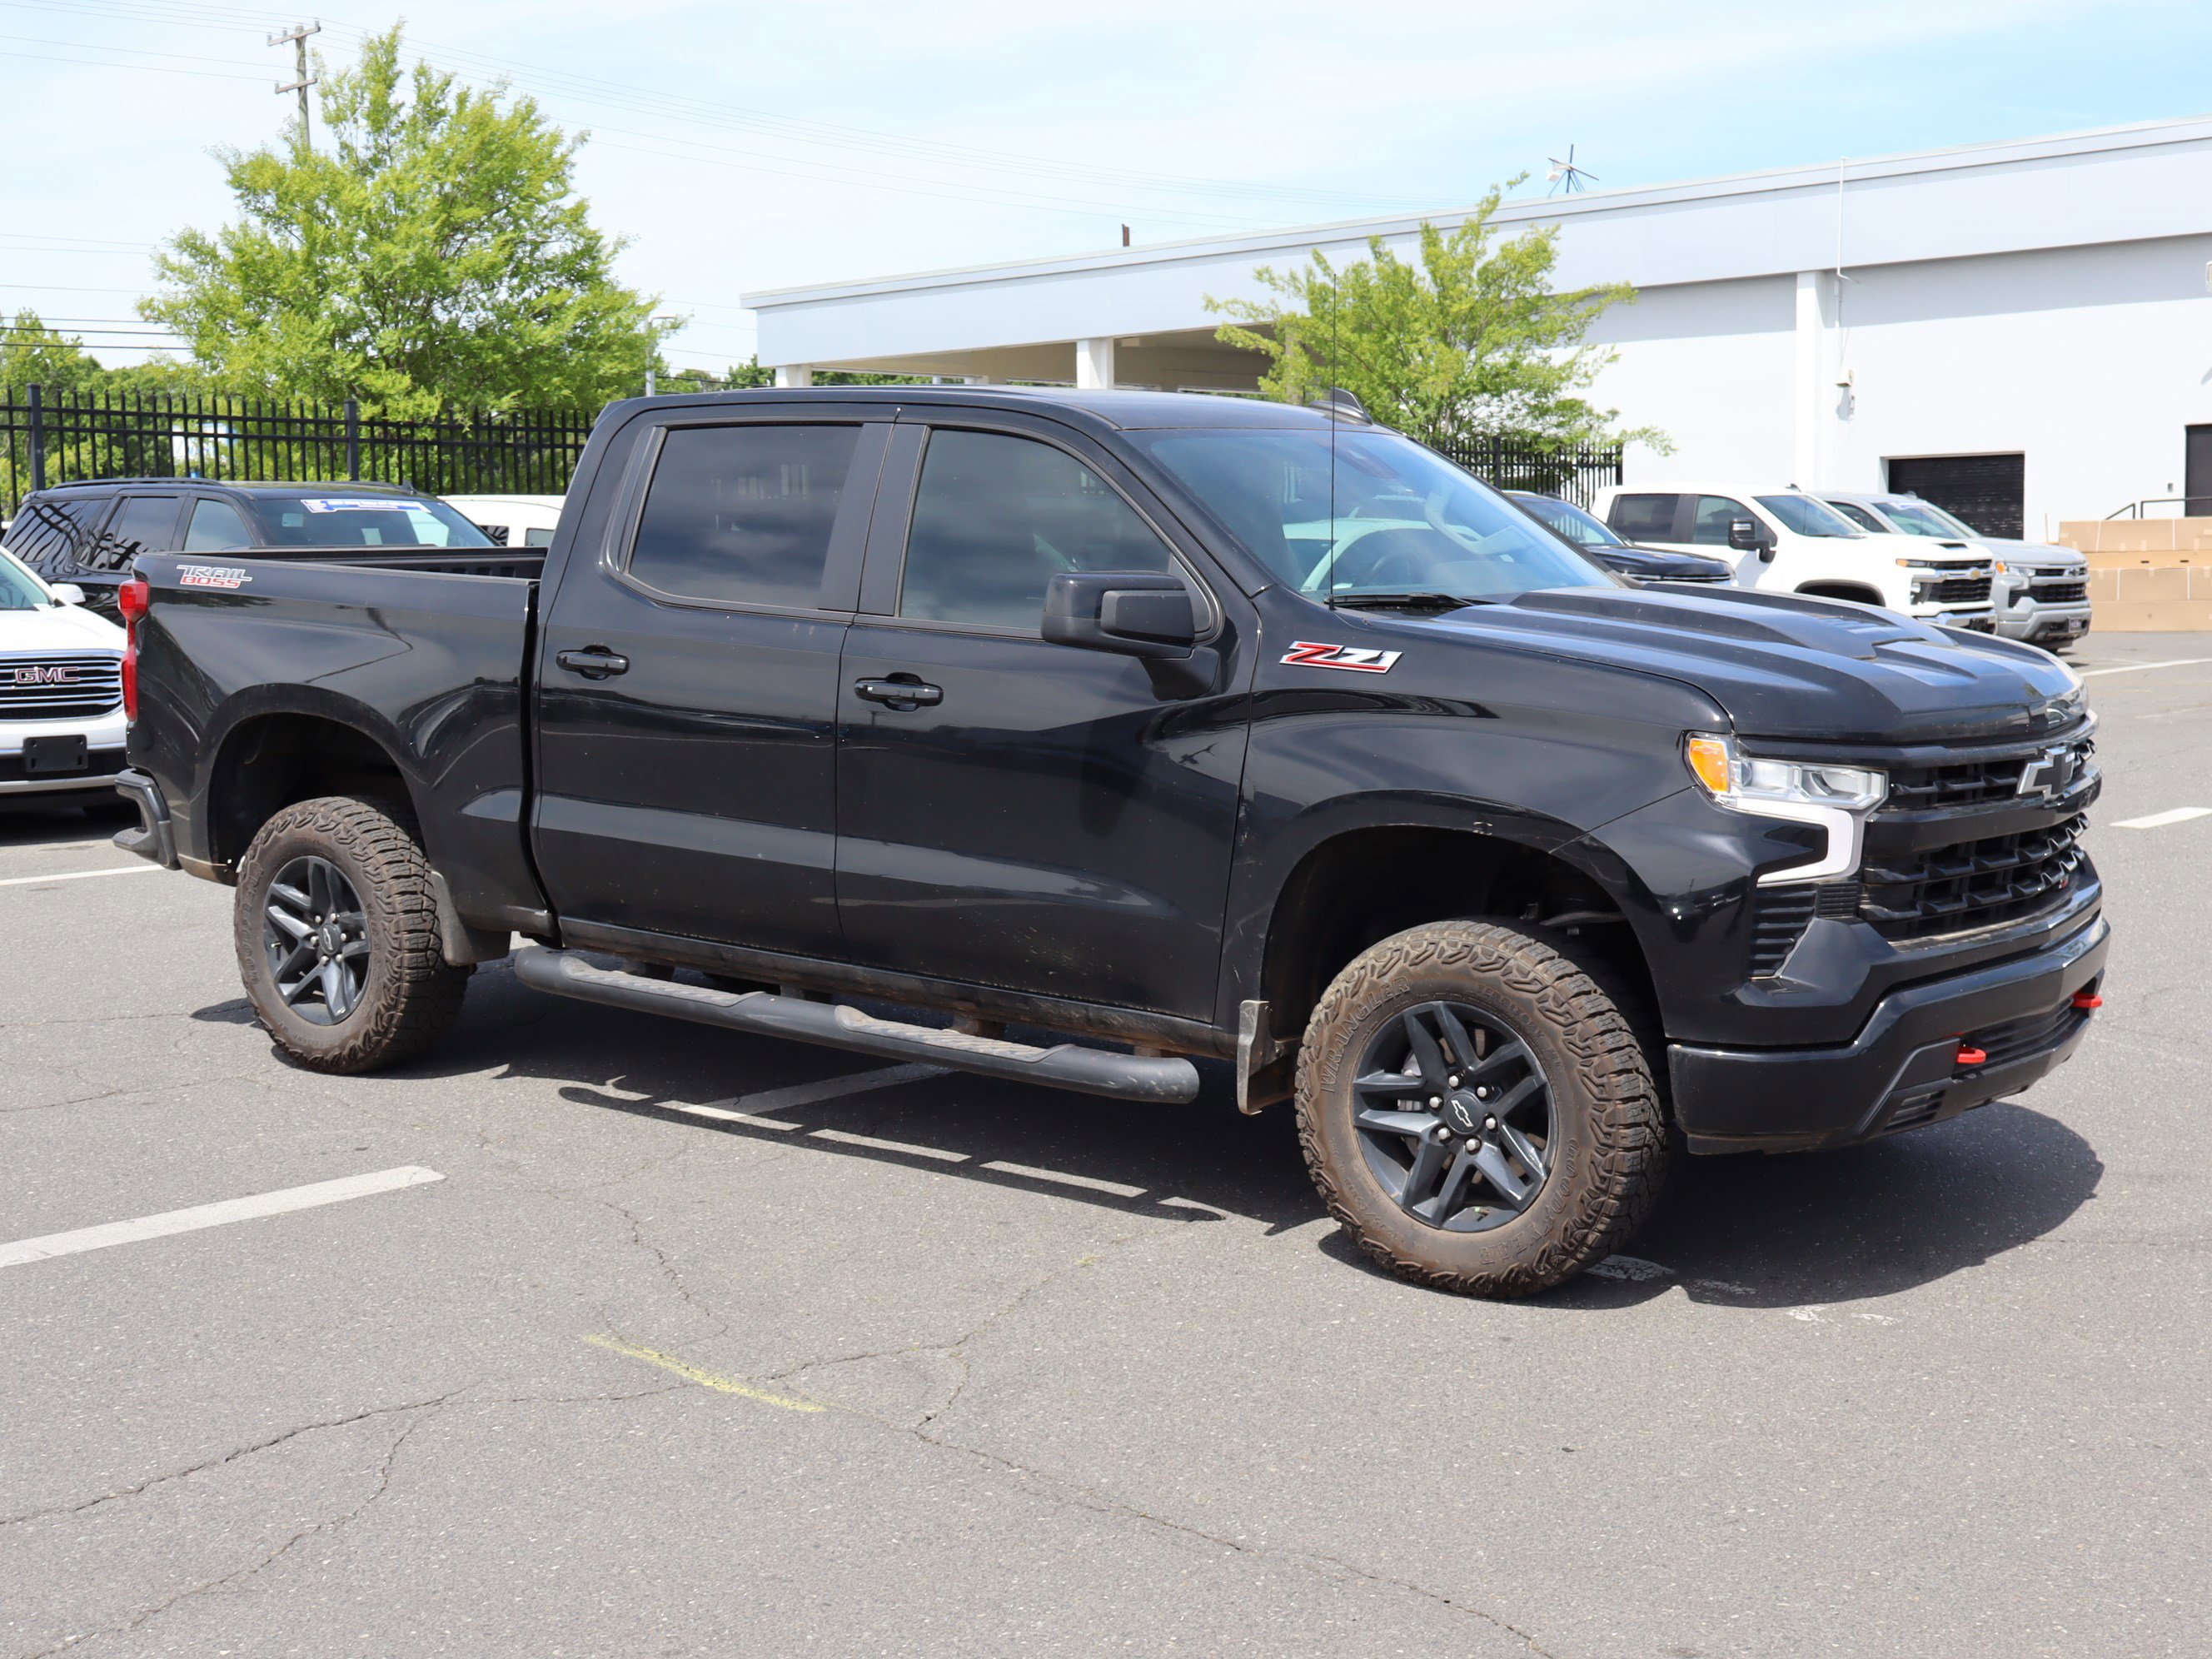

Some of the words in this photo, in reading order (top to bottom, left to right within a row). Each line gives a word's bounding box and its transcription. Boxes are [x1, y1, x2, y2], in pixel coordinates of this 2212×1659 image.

[177, 565, 253, 581] TRAIL
[180, 575, 241, 588] BOSS
[1279, 640, 1403, 674] Z71
[14, 666, 81, 684] GMC
[1320, 976, 1411, 1094] WRANGLER
[1478, 1138, 1580, 1265] GOODYEAR
